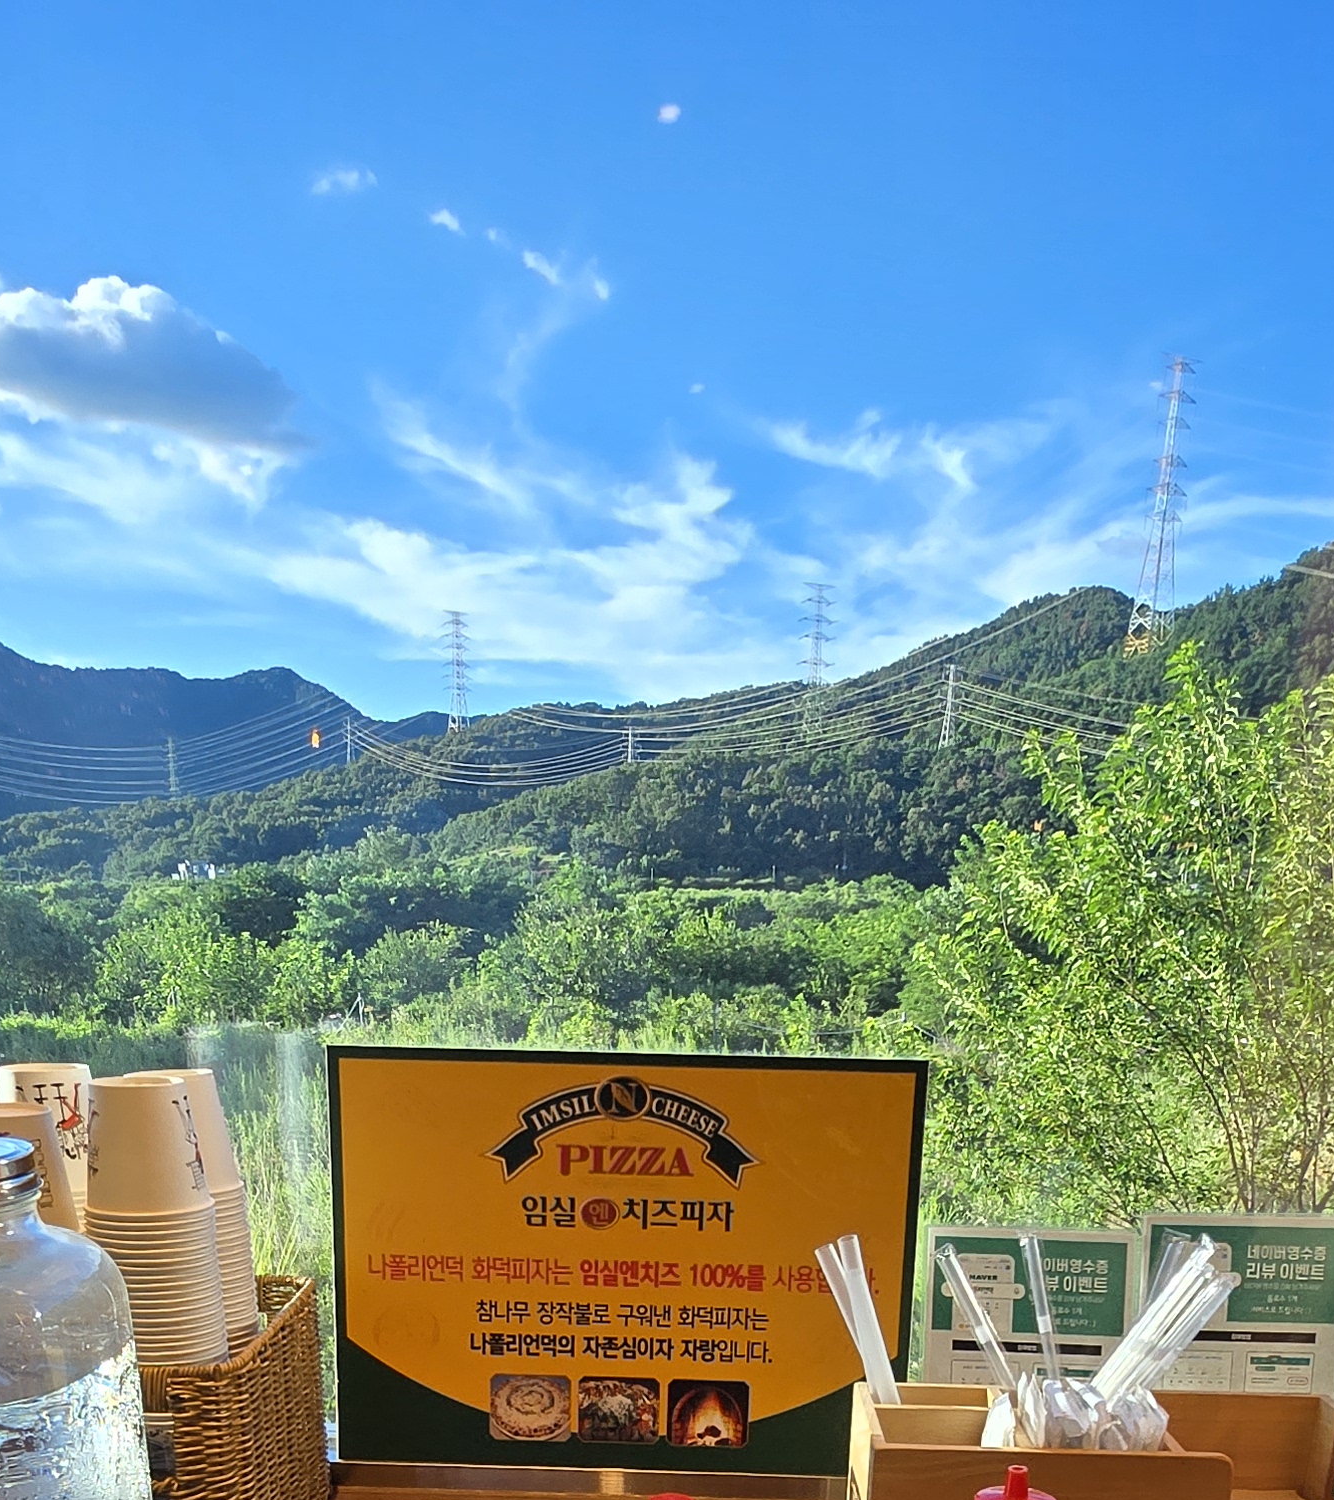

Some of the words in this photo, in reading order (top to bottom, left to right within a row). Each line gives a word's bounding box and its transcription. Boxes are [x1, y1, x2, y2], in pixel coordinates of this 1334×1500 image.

[530, 1094, 597, 1132] IMSIL
[651, 1096, 720, 1139] CHEESE
[556, 1143, 695, 1178] PIZZA
[521, 1195, 735, 1233] 임실엔치즈피자
[1041, 1257, 1109, 1275] 이버영수증
[1247, 1244, 1327, 1262] 네이버영수증
[367, 1253, 465, 1283] 나폴리언덕
[470, 1255, 574, 1286] 화덕피자는
[579, 1258, 682, 1288] 임실엔치즈
[689, 1262, 767, 1292] 100%를
[1063, 1276, 1109, 1294] 이벤트
[1246, 1262, 1277, 1280] 리뷰
[1279, 1262, 1326, 1281] 이벤트
[475, 1299, 532, 1324] 참나무
[536, 1300, 612, 1326] 장작불로
[616, 1304, 672, 1329] 구워낸
[677, 1304, 770, 1331] 화덕피자는
[469, 1331, 576, 1358] 나폴리언덕의
[582, 1335, 675, 1362] 자존심이자
[679, 1338, 773, 1364] 자랑입니다.
